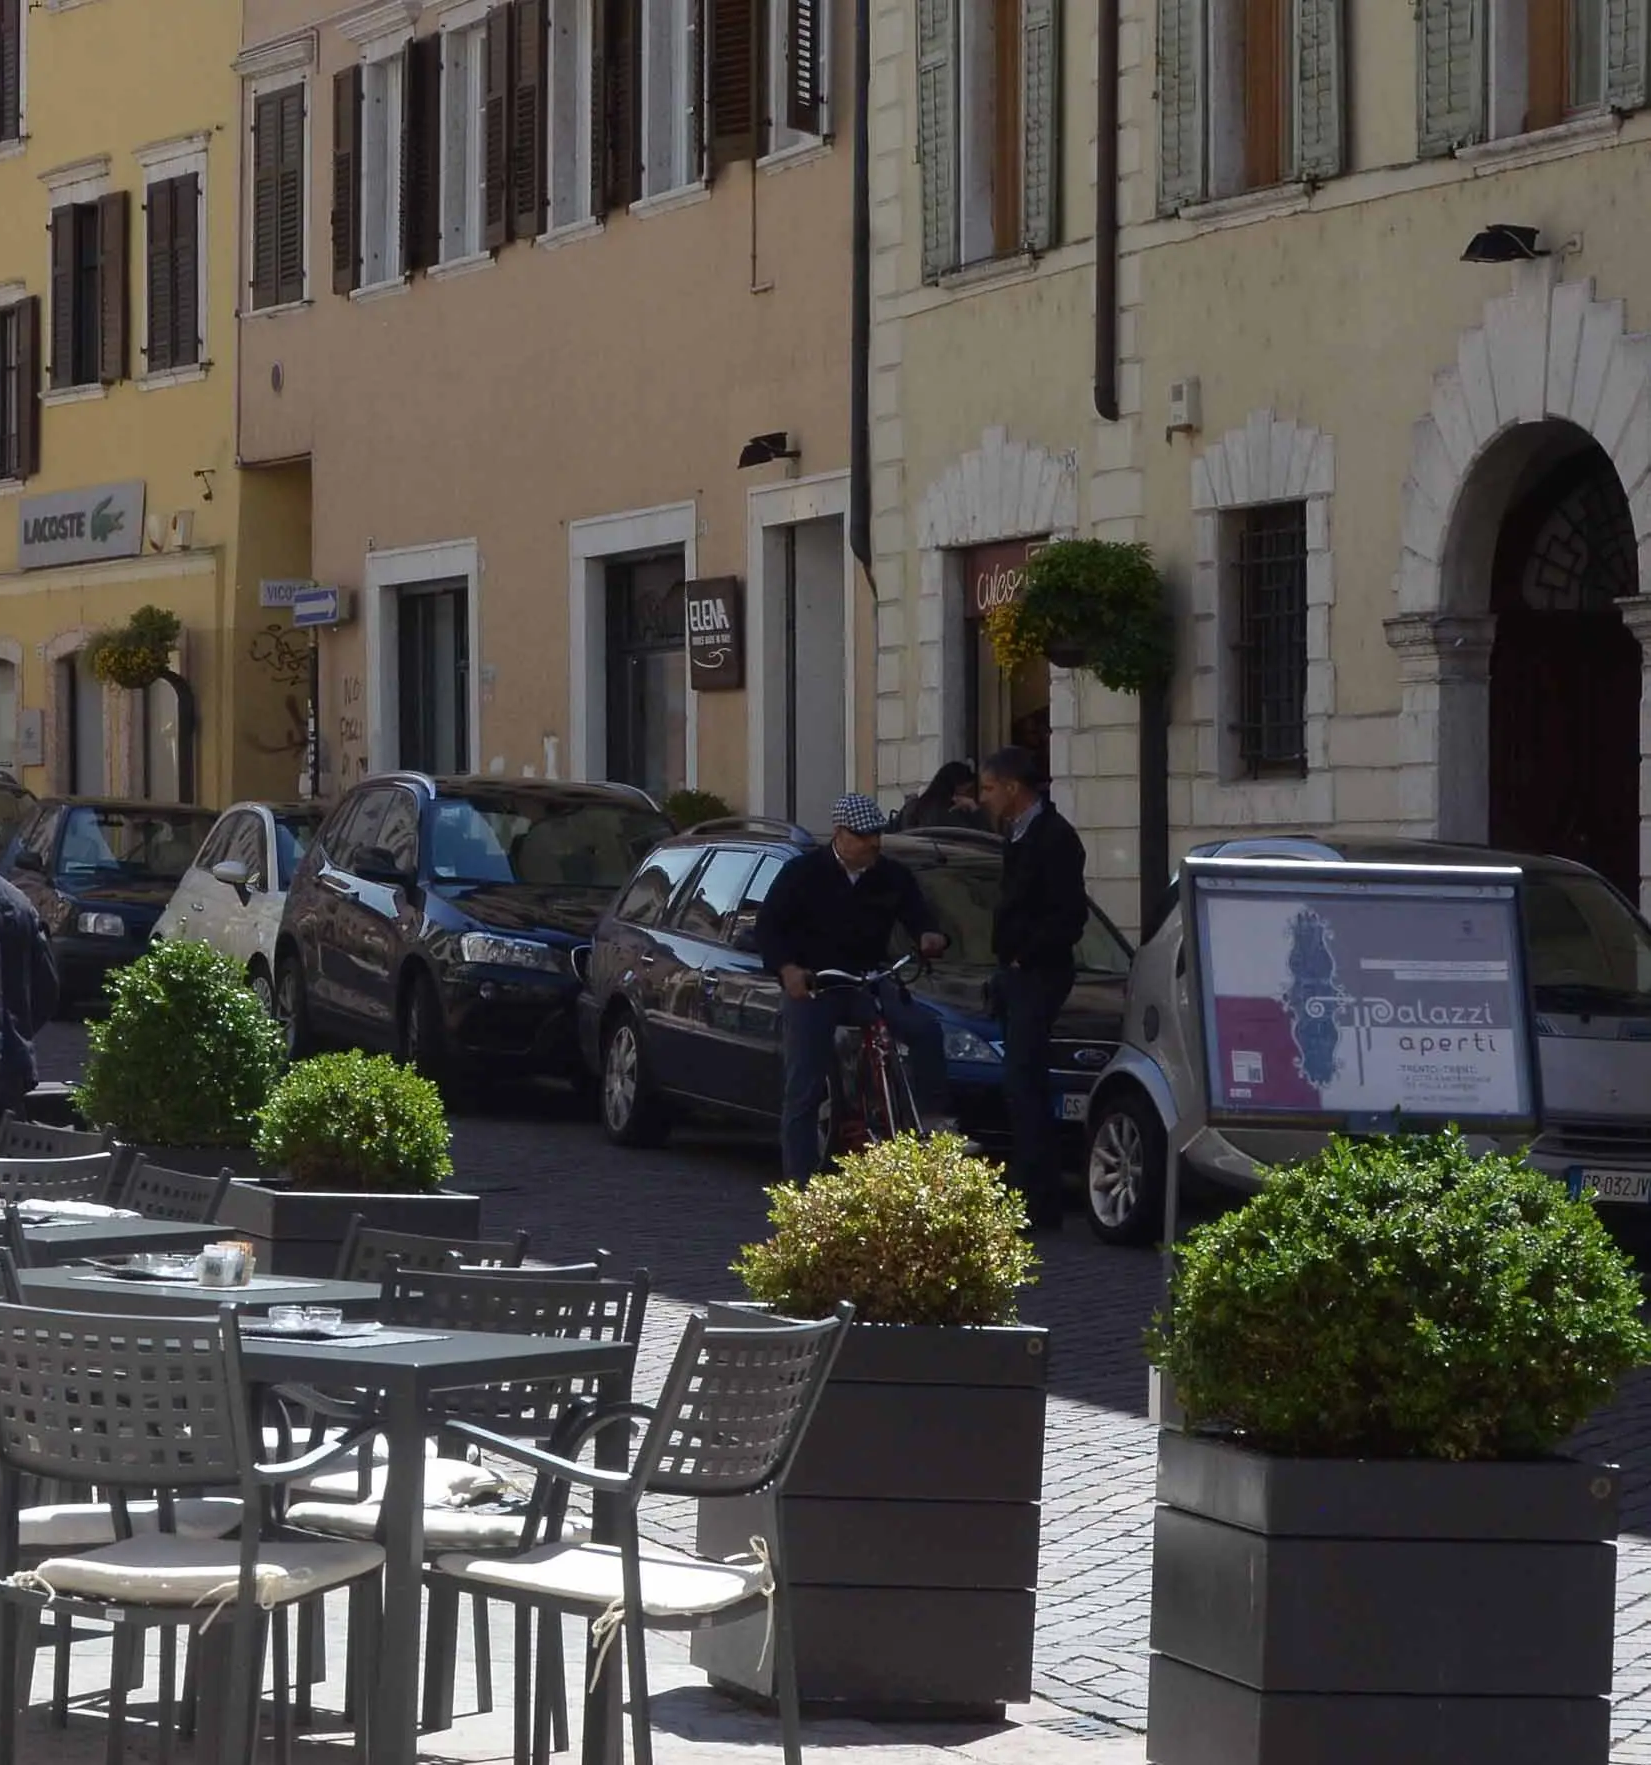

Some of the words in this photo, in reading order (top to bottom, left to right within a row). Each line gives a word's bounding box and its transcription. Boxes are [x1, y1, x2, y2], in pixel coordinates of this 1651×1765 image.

[23, 511, 86, 545] LACOSTE
[267, 584, 306, 602] VICO
[689, 598, 730, 632] ELENA
[1354, 996, 1495, 1030] Palazzi
[1399, 1032, 1496, 1056] aperti
